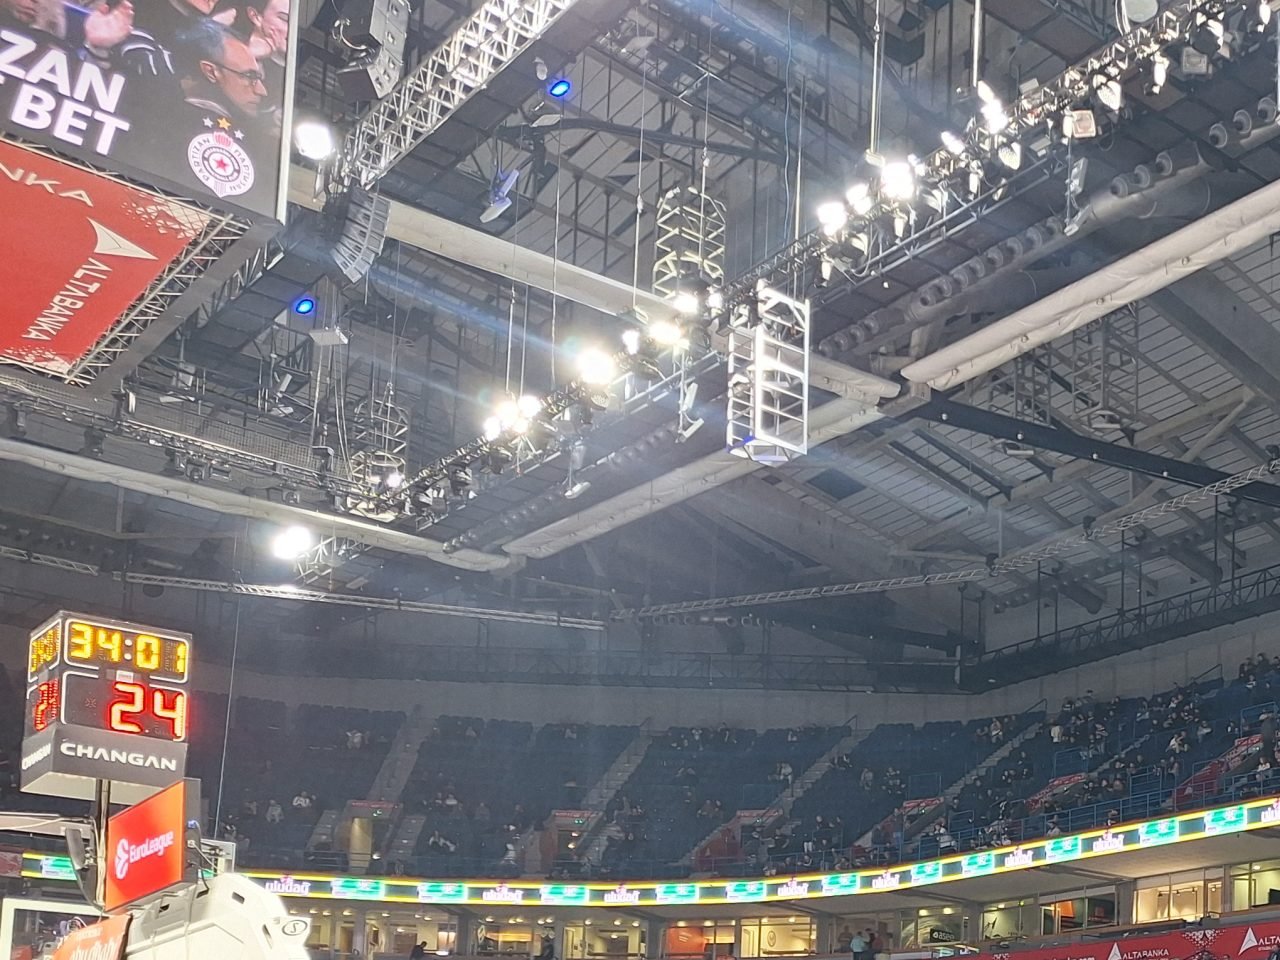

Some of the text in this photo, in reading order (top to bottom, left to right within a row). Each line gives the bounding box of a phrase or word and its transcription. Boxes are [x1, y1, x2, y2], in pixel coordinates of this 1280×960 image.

[11, 83, 130, 156] BET
[21, 257, 113, 341] ALTABANKA
[70, 623, 186, 673] 34:01
[109, 682, 184, 738] 24
[60, 742, 177, 771] CHANGAN
[130, 831, 173, 864] EuroLeague
[1122, 948, 1169, 960] ALTABANKA
